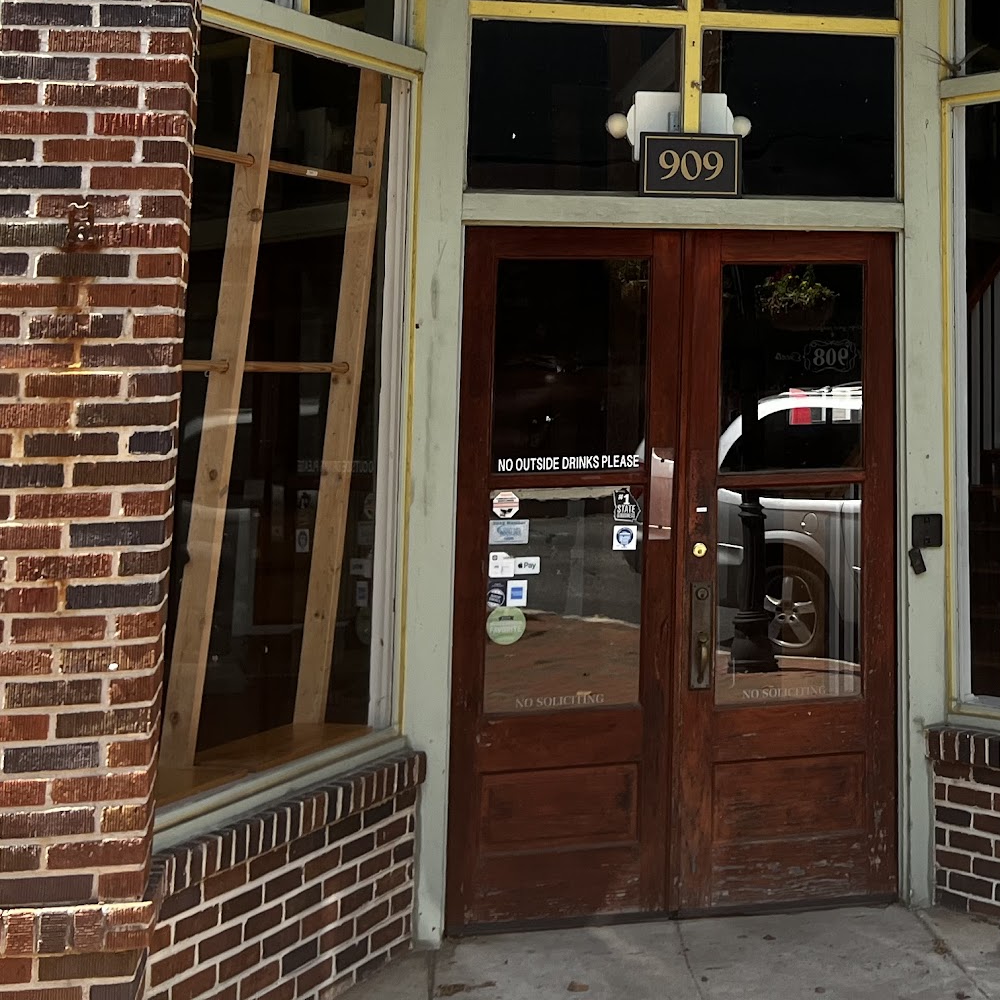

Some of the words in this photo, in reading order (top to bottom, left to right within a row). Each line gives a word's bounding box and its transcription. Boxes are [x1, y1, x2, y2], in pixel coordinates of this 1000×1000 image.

[658, 149, 724, 181] 909
[497, 458, 514, 472] NO
[515, 456, 560, 471] OUTSIDE
[562, 455, 600, 470] DRINKS
[601, 454, 640, 468] PLEASE
[617, 493, 631, 505] #1
[616, 504, 636, 513] STATE
[523, 561, 537, 570] Pay
[742, 688, 760, 699] NO
[762, 685, 826, 698] SOLICITING
[515, 697, 534, 708] NO
[536, 693, 605, 707] SOLICITING
